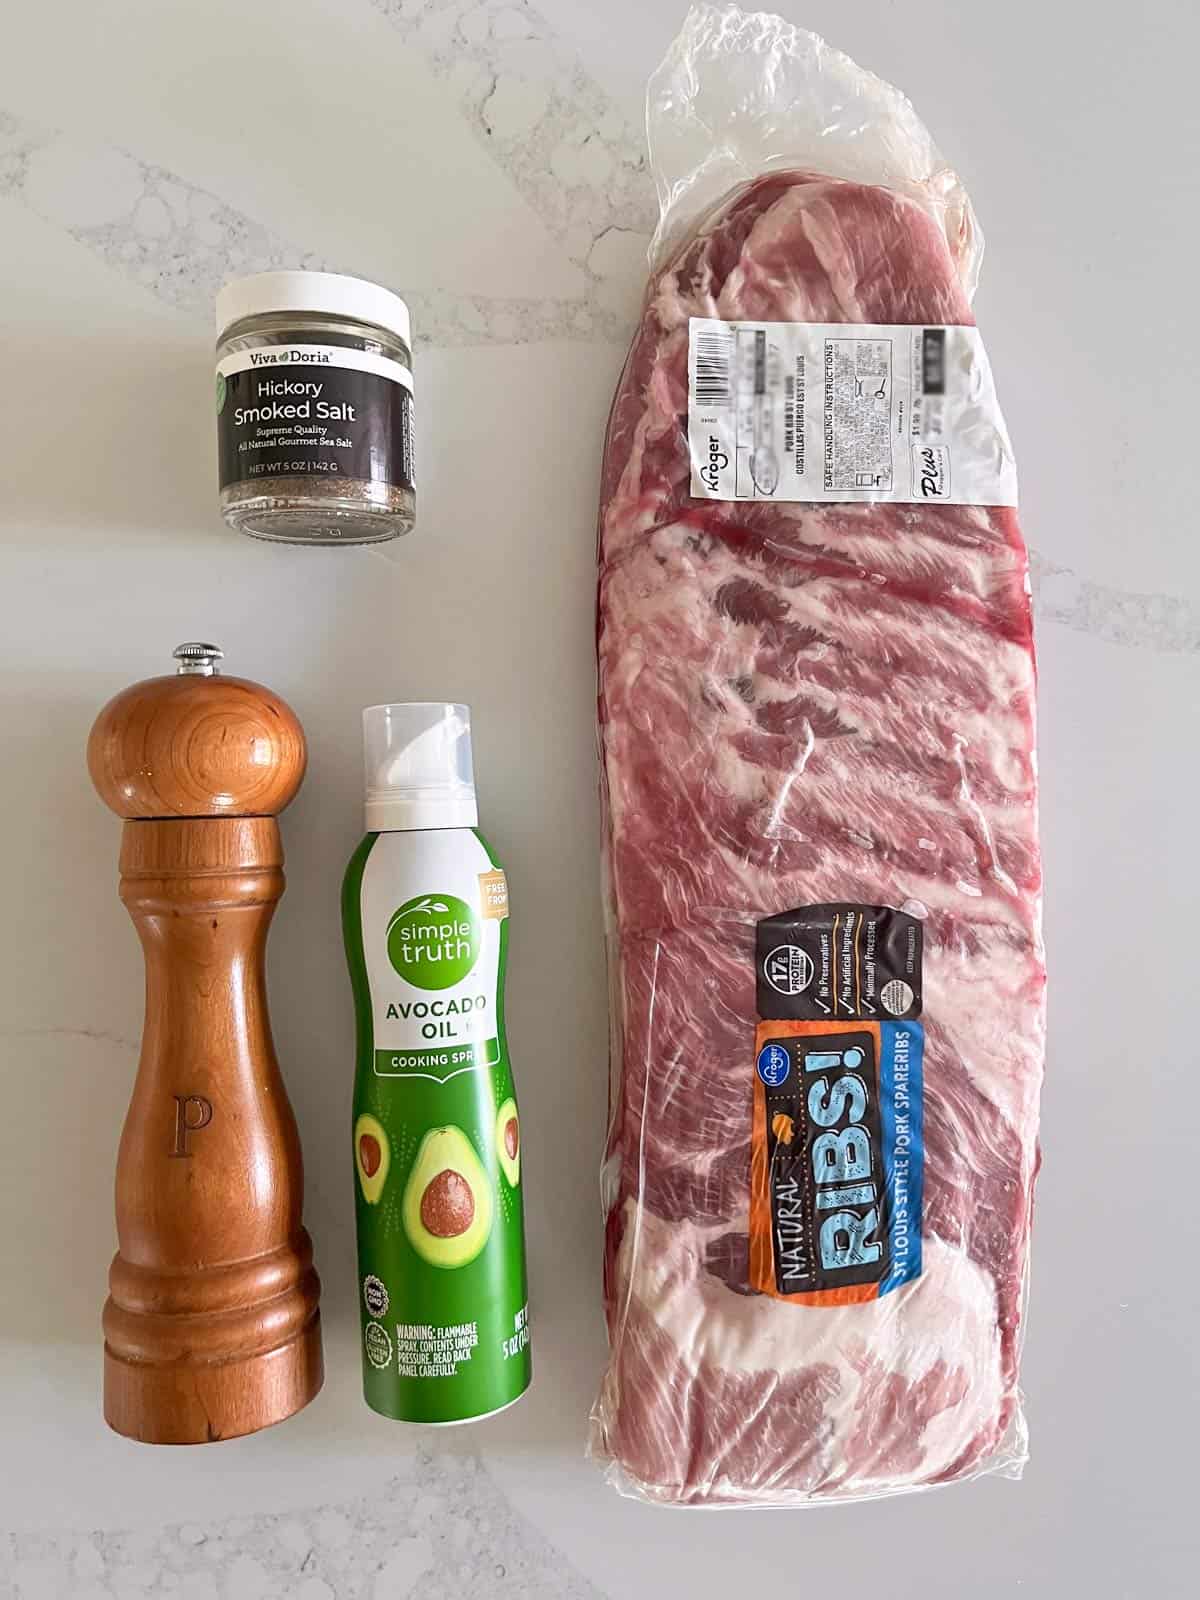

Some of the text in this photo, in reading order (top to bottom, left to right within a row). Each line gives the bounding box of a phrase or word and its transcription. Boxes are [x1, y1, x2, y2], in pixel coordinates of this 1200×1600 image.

[250, 353, 278, 365] Viva
[258, 380, 323, 398] Hickory
[234, 401, 356, 425] Smoked Salt
[825, 344, 834, 488] SAFE HANDLING INSTRUCTIONS
[256, 425, 328, 438] Supreme Quality
[238, 437, 353, 452] All Natural Gourmet Sea Salt
[249, 463, 266, 473] NET
[266, 462, 283, 472] WT
[283, 462, 290, 471] 5
[291, 461, 306, 471] OZ
[312, 461, 329, 471] 142
[329, 462, 338, 472] G
[700, 436, 729, 492] Kroger
[921, 447, 942, 497] Plus
[400, 920, 471, 941] simple
[842, 911, 856, 953] Ingredients
[864, 920, 876, 960] Processed
[401, 938, 471, 963] truth
[791, 948, 801, 991] PROTEIN
[819, 934, 829, 997] No Preservatives
[841, 953, 851, 986] Artificial
[386, 995, 487, 1019] AVOCADO
[421, 1021, 458, 1039] OIL
[391, 1054, 449, 1068] COOKING
[764, 1047, 784, 1084] Kroger
[805, 1047, 883, 1270] RIBS!
[894, 1031, 911, 1277] ST LOUIS STYLE PORK SPARERIBS
[775, 1177, 810, 1280] NATURAL
[396, 1321, 478, 1340] WARNING: FLAMMABLE
[420, 1338, 454, 1352] CONTENTS
[455, 1334, 479, 1349] UNDER
[502, 1341, 508, 1361] 5
[509, 1334, 519, 1356] OZ
[433, 1350, 452, 1364] READ
[452, 1347, 472, 1362] BACK
[398, 1362, 458, 1377] PANEL CAREFULLY.
